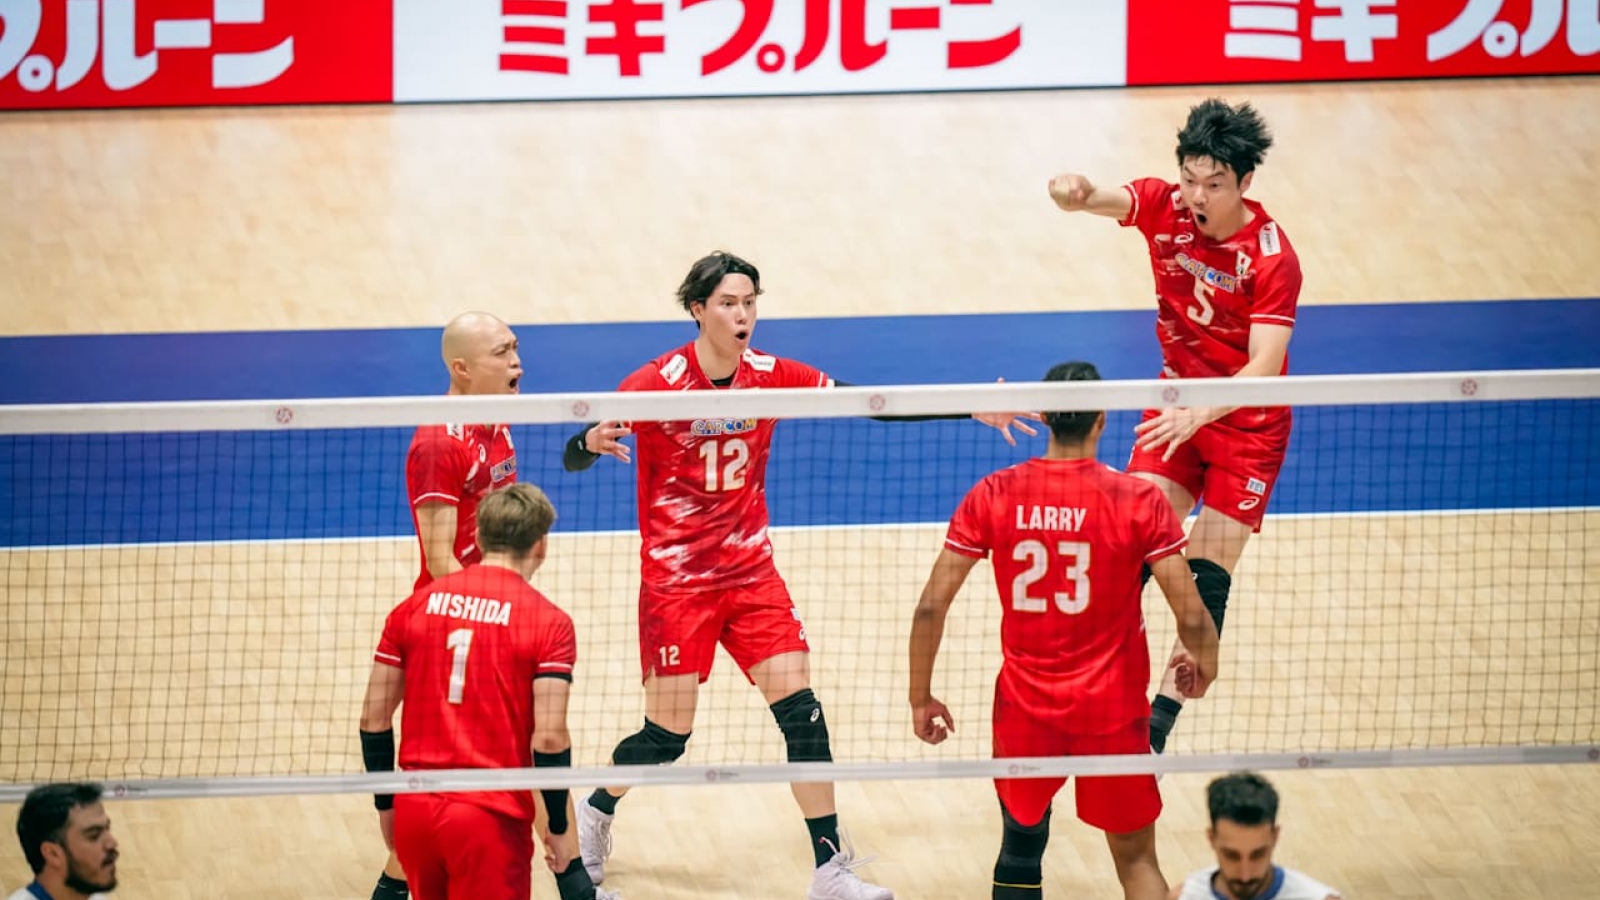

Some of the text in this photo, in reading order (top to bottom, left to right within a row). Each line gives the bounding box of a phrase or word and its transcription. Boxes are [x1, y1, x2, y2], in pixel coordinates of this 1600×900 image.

[499, 0, 1021, 76] ミキプルーン
[1187, 274, 1215, 325] 5
[690, 418, 757, 436] CAPCOM
[699, 438, 749, 491] 12
[1016, 505, 1087, 532] LARRY
[1012, 539, 1091, 614] 23
[426, 592, 512, 627] NISHIDA
[446, 628, 474, 704] 1
[659, 645, 680, 667] 12
